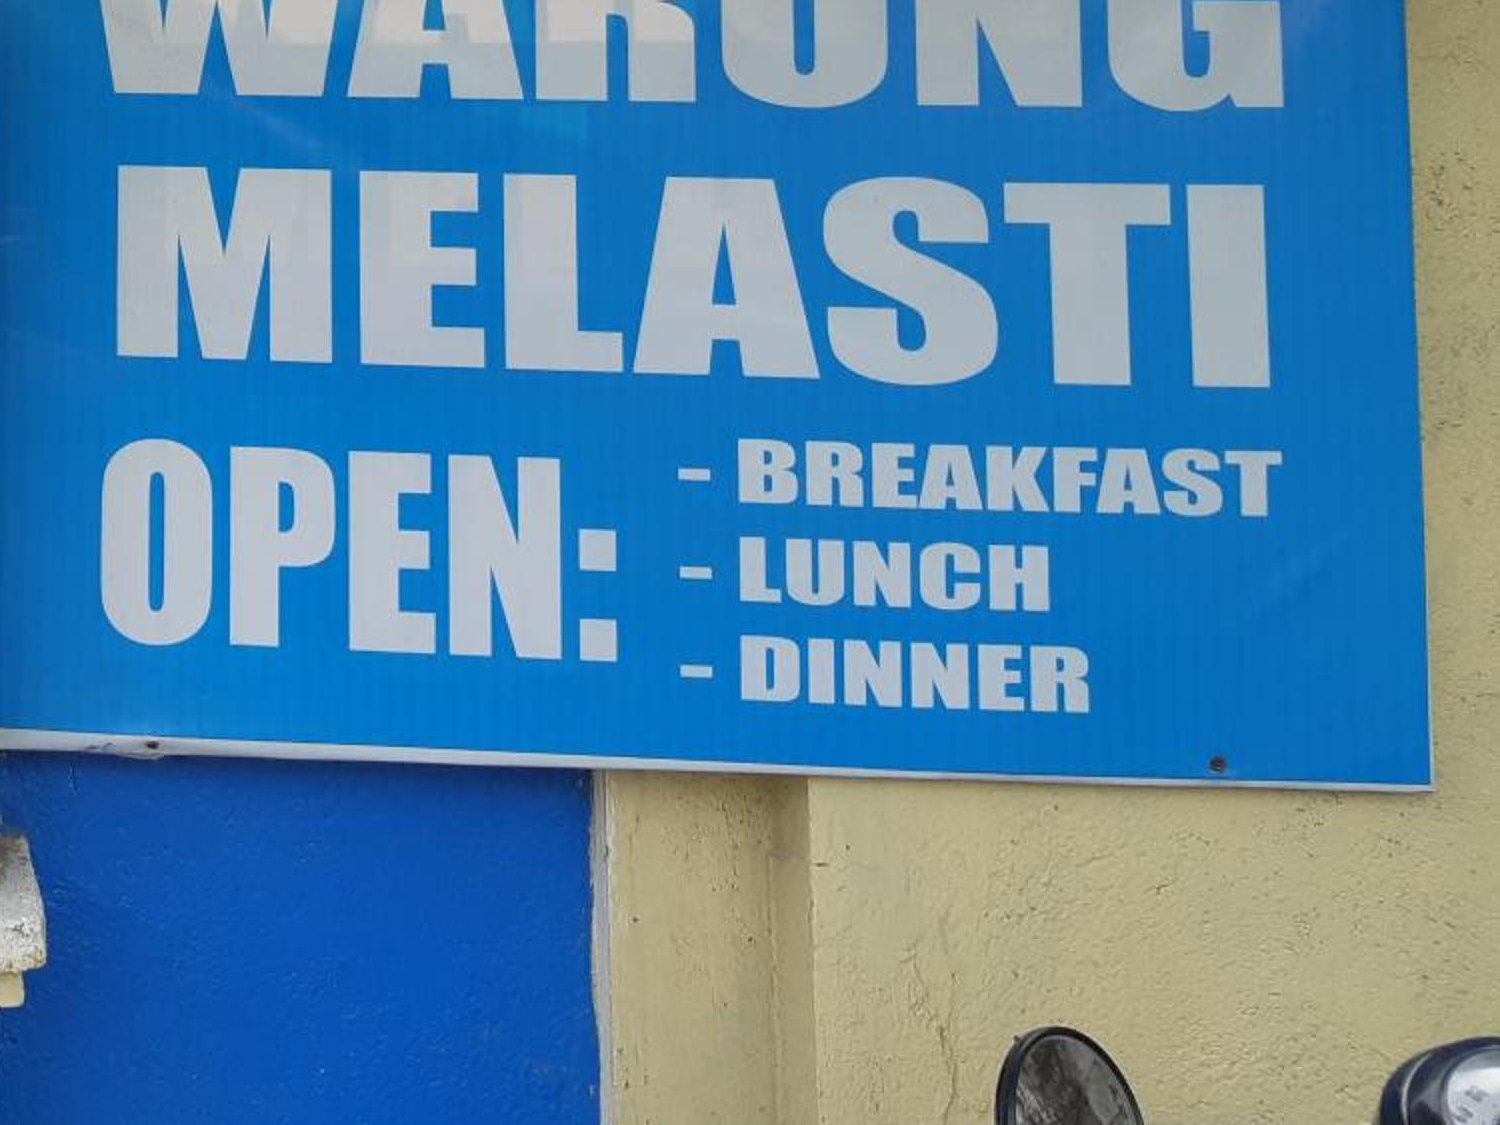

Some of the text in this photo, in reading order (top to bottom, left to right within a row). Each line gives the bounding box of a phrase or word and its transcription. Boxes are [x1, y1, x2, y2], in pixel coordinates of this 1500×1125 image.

[117, 165, 1271, 388] MELASTI
[738, 439, 1283, 517] BREAKFAST
[100, 439, 618, 661] OPEN:
[739, 537, 1051, 613] LUNCH
[740, 635, 1090, 714] DINNER
